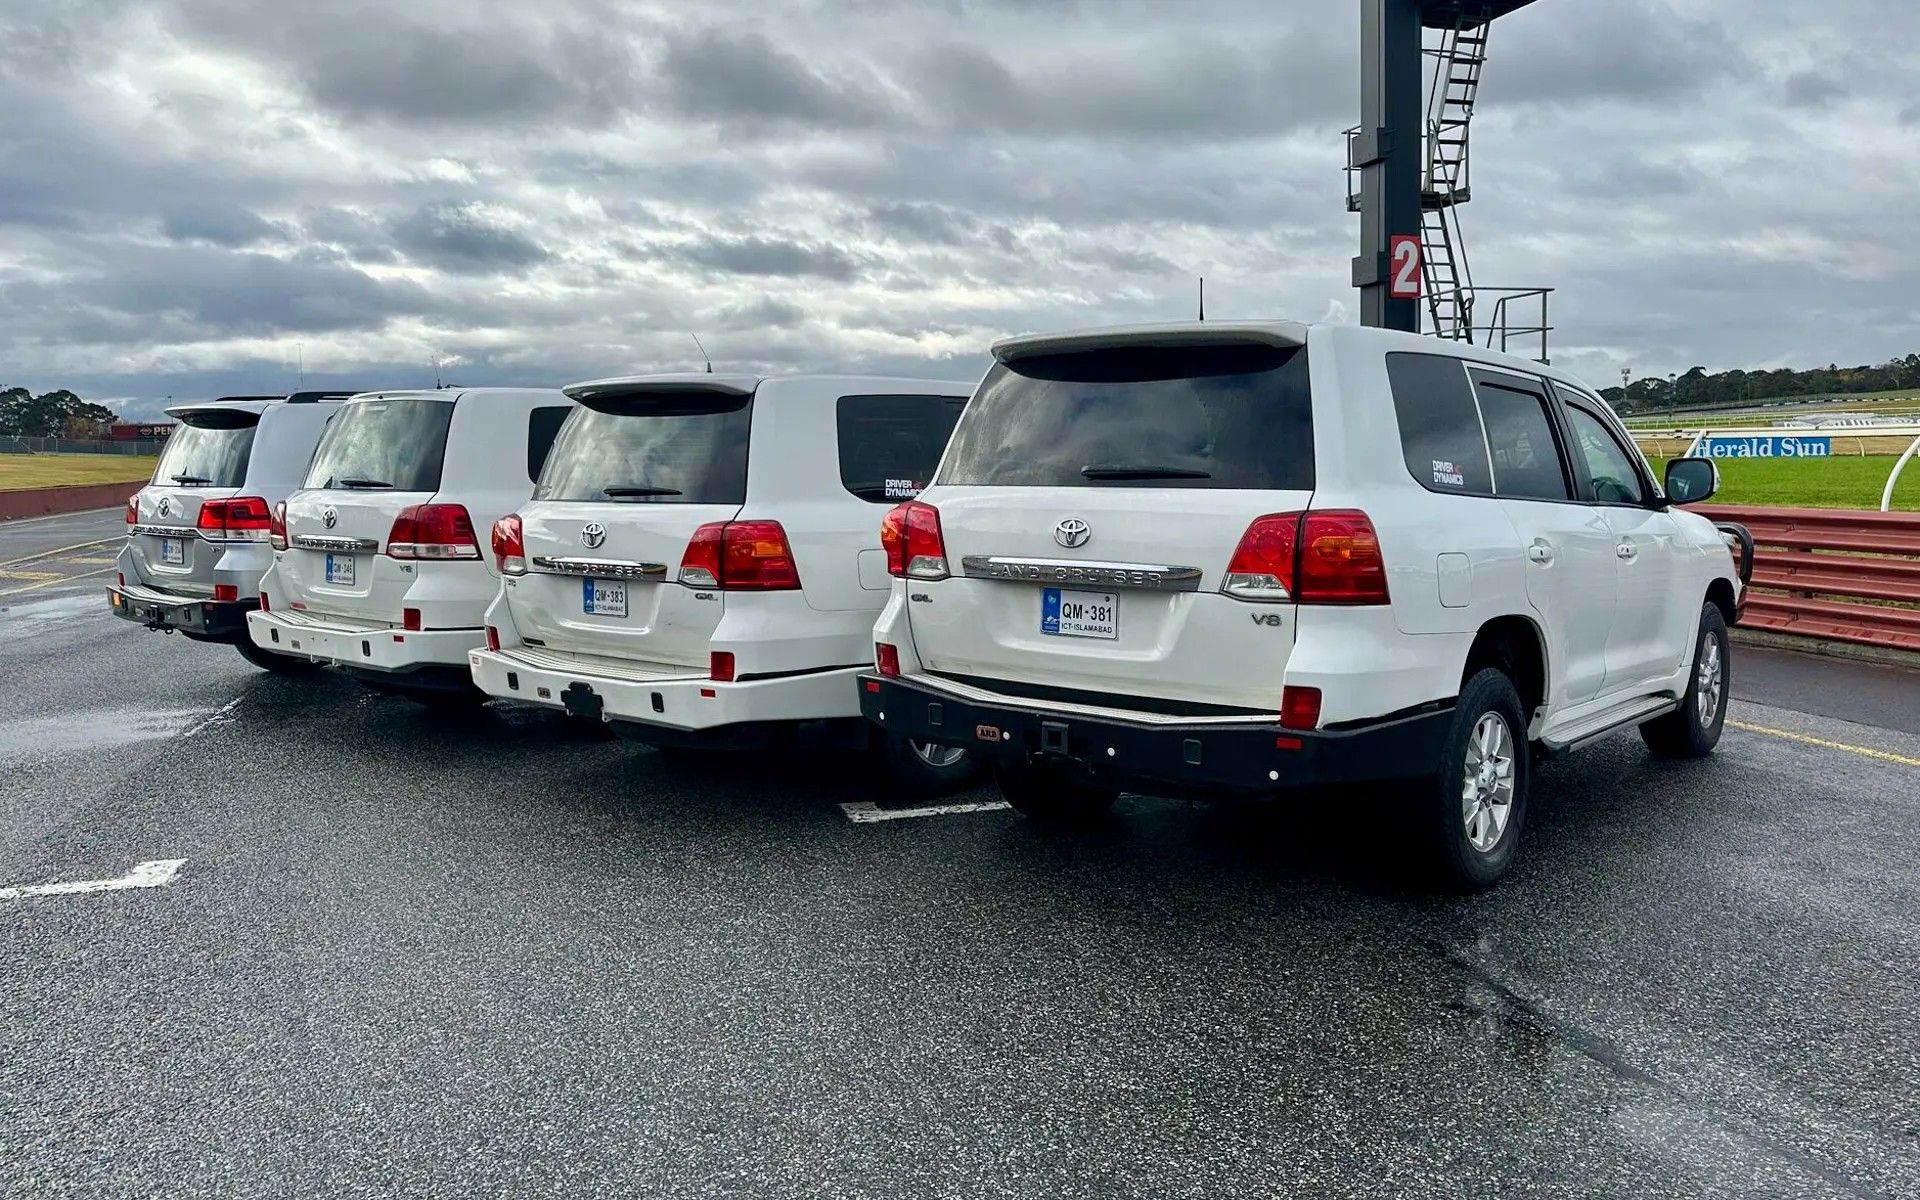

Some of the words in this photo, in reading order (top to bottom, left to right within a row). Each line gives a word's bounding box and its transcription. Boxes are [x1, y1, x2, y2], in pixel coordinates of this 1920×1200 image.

[1394, 240, 1418, 293] 2
[1694, 438, 1773, 458] Herald
[1780, 437, 1827, 458] Sun
[1432, 460, 1454, 473] DRIVER
[885, 479, 913, 489] DRIVER
[1433, 471, 1464, 485] DYNAMICS
[989, 563, 1041, 579] LAND
[1055, 566, 1162, 586] CRUISER
[594, 588, 624, 604] QM-383
[1062, 602, 1113, 622] QM-381
[1250, 613, 1281, 626] V8
[1061, 622, 1113, 634] ICT-ISLAMABAD
